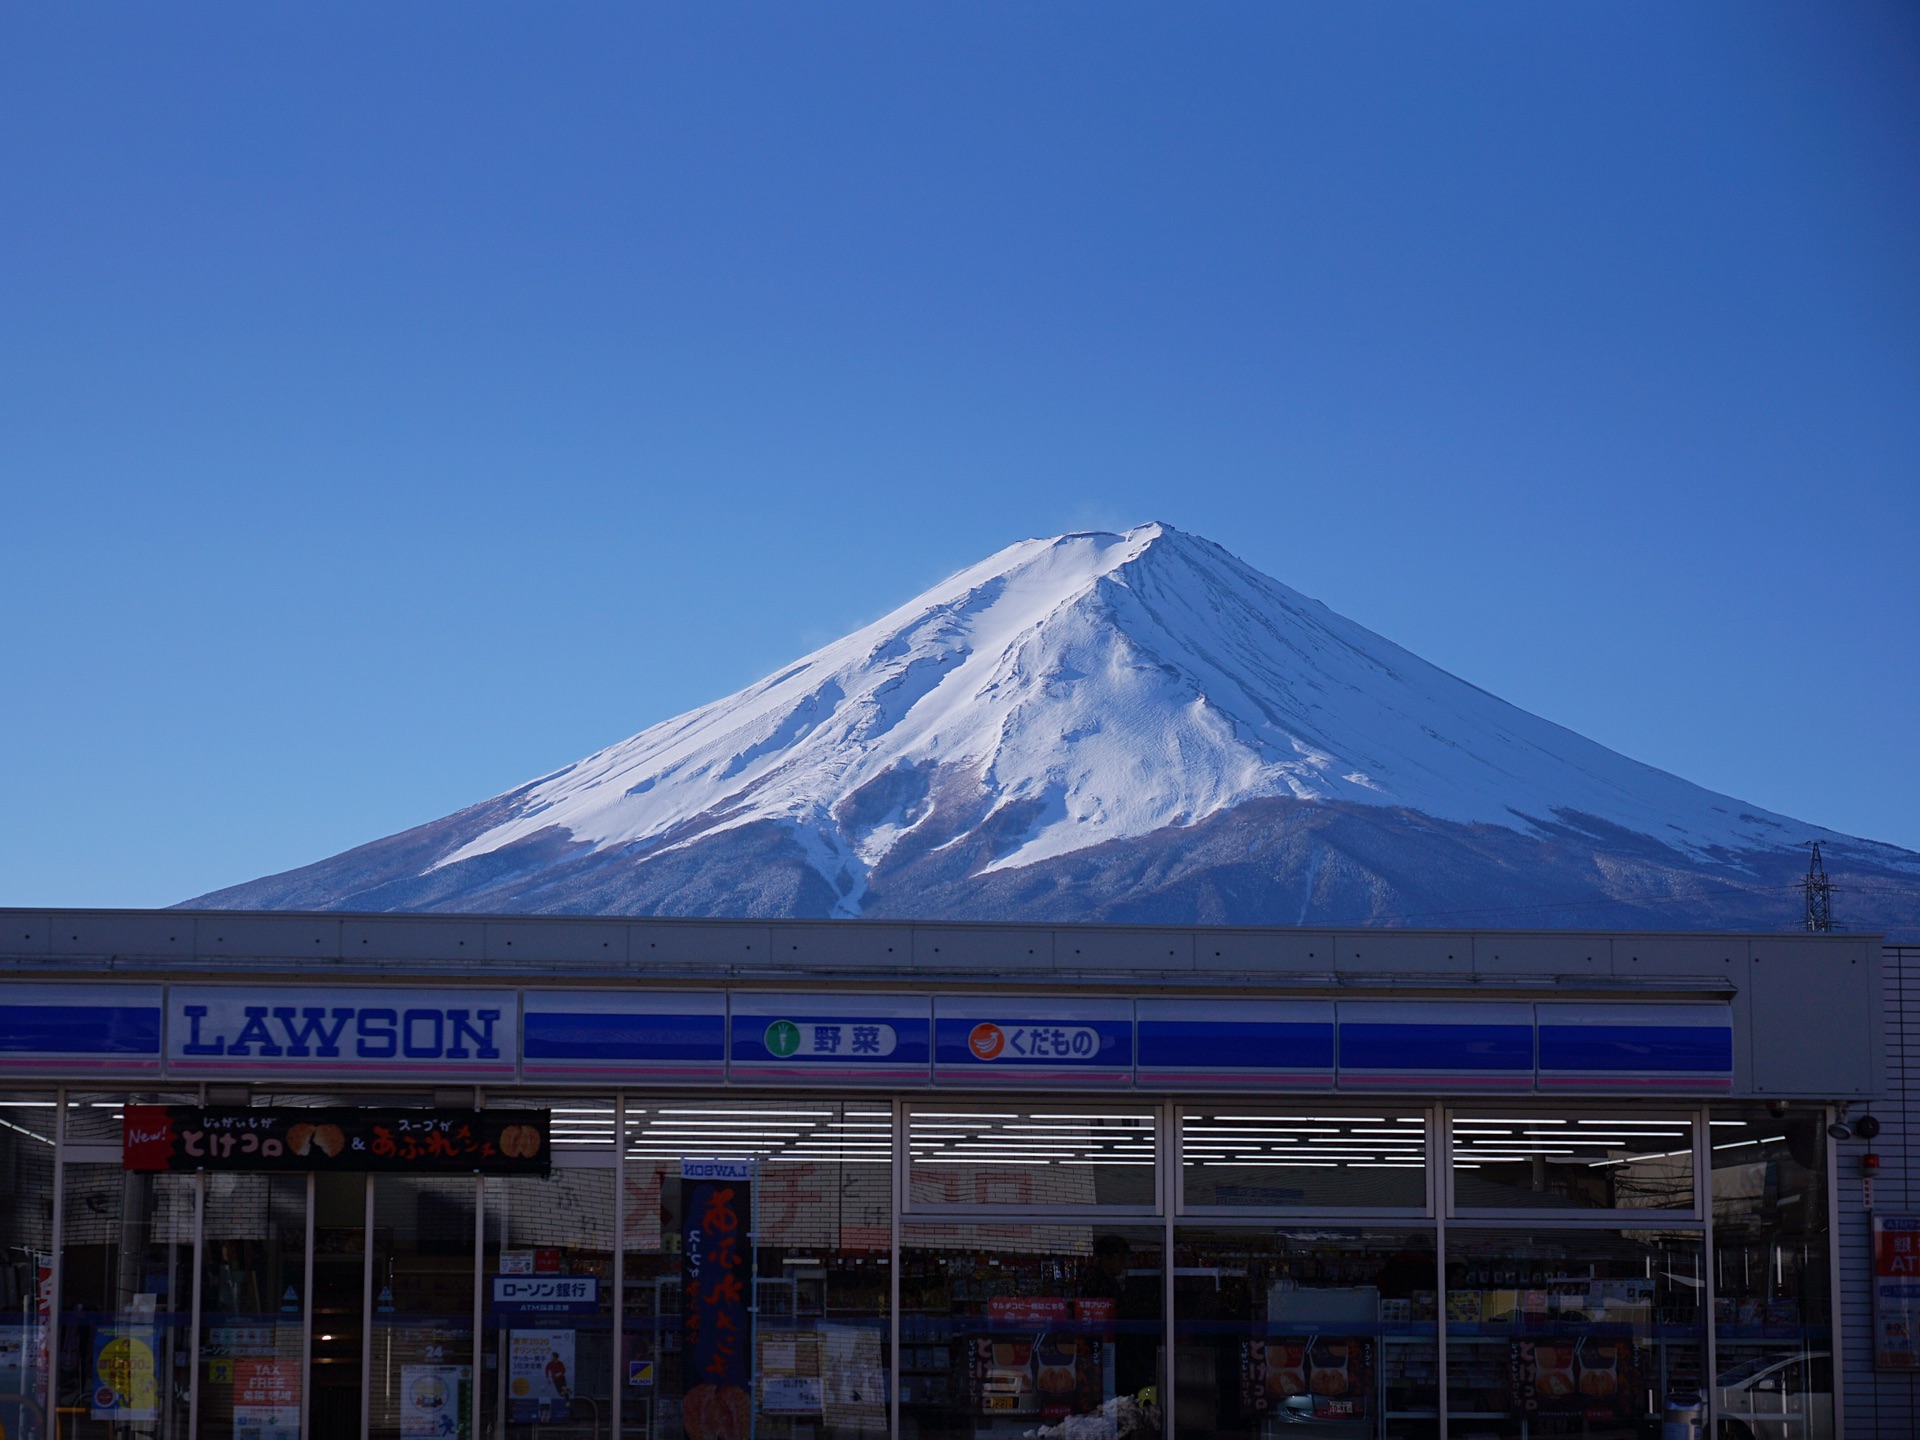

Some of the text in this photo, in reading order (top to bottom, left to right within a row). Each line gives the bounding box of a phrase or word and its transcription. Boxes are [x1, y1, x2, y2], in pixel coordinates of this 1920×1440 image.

[184, 1005, 500, 1059] LAWSON
[814, 1026, 880, 1054] 野菜
[1010, 1030, 1093, 1056] くだもの
[204, 1117, 277, 1128] じゃがいもが
[399, 1119, 453, 1132] スープが
[128, 1126, 166, 1147] New!
[182, 1130, 283, 1158] とけコロ
[352, 1137, 366, 1150] &
[1895, 1236, 1920, 1253] 銀
[1890, 1256, 1920, 1272] AT
[503, 1283, 586, 1297] ローソン銀行
[255, 1364, 281, 1376] TAX
[249, 1377, 286, 1389] FREE
